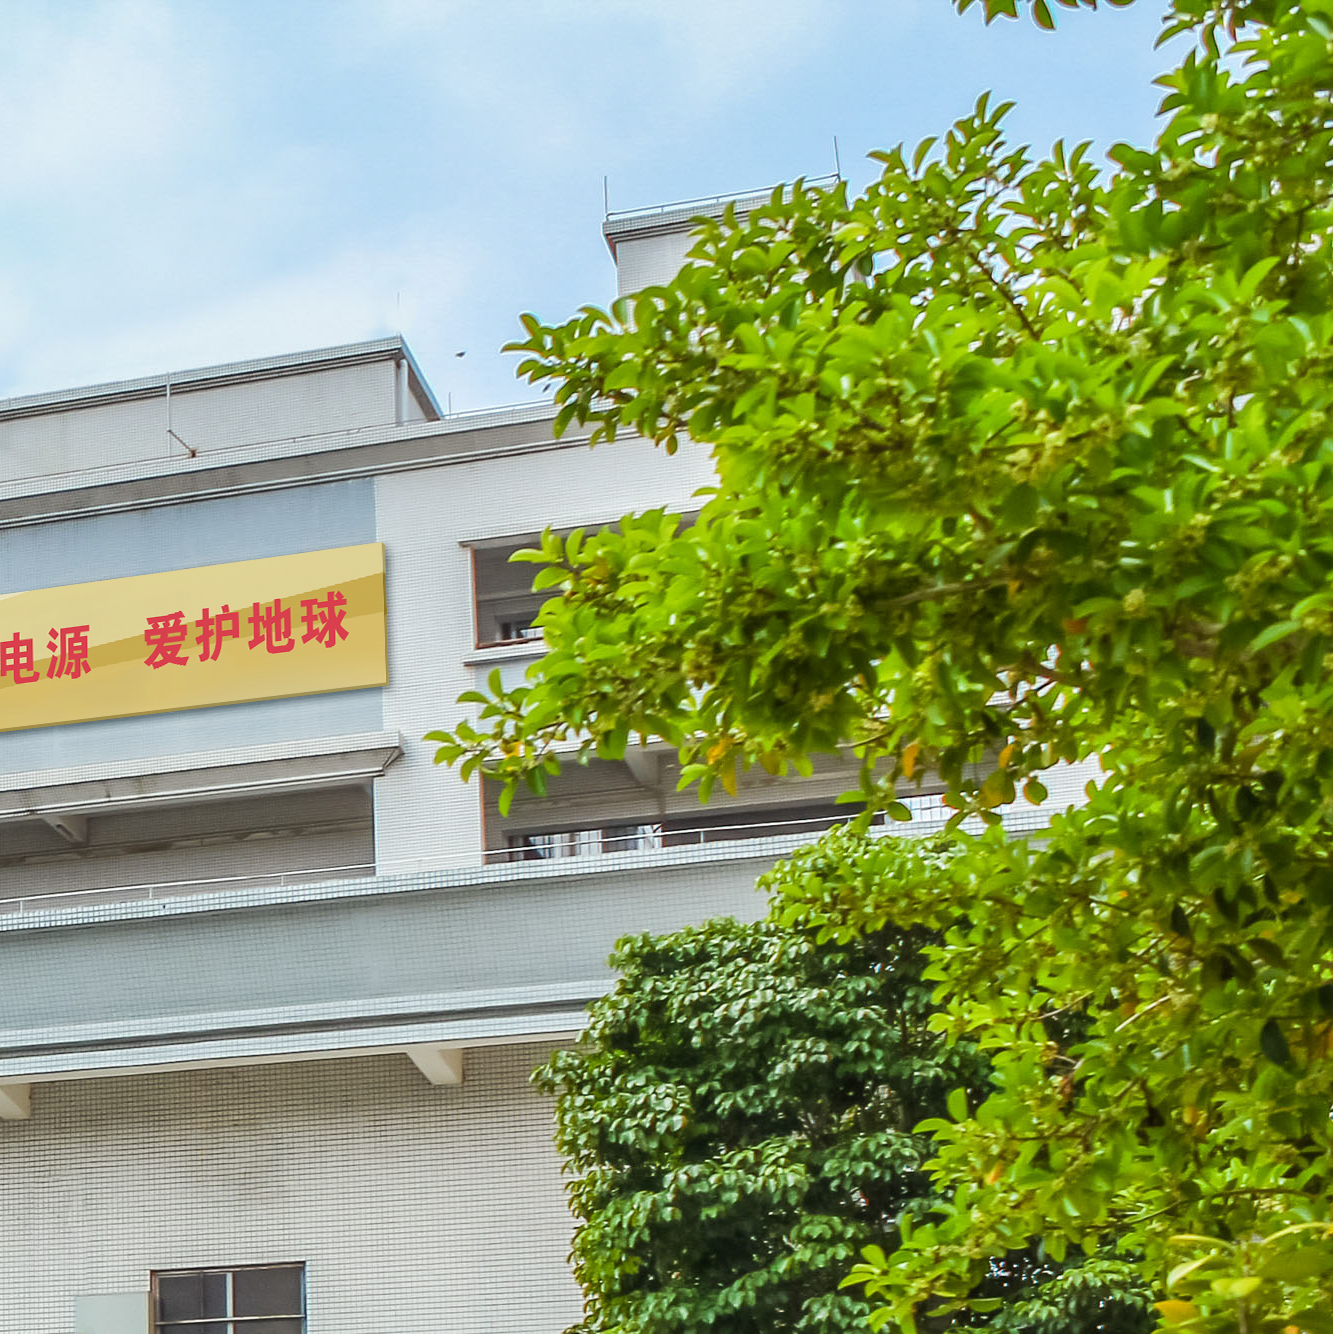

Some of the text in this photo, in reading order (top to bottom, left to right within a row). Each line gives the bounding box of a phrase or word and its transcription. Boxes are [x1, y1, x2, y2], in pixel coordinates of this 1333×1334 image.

[0, 624, 92, 684] 电源
[143, 591, 349, 670] 爱护地球
